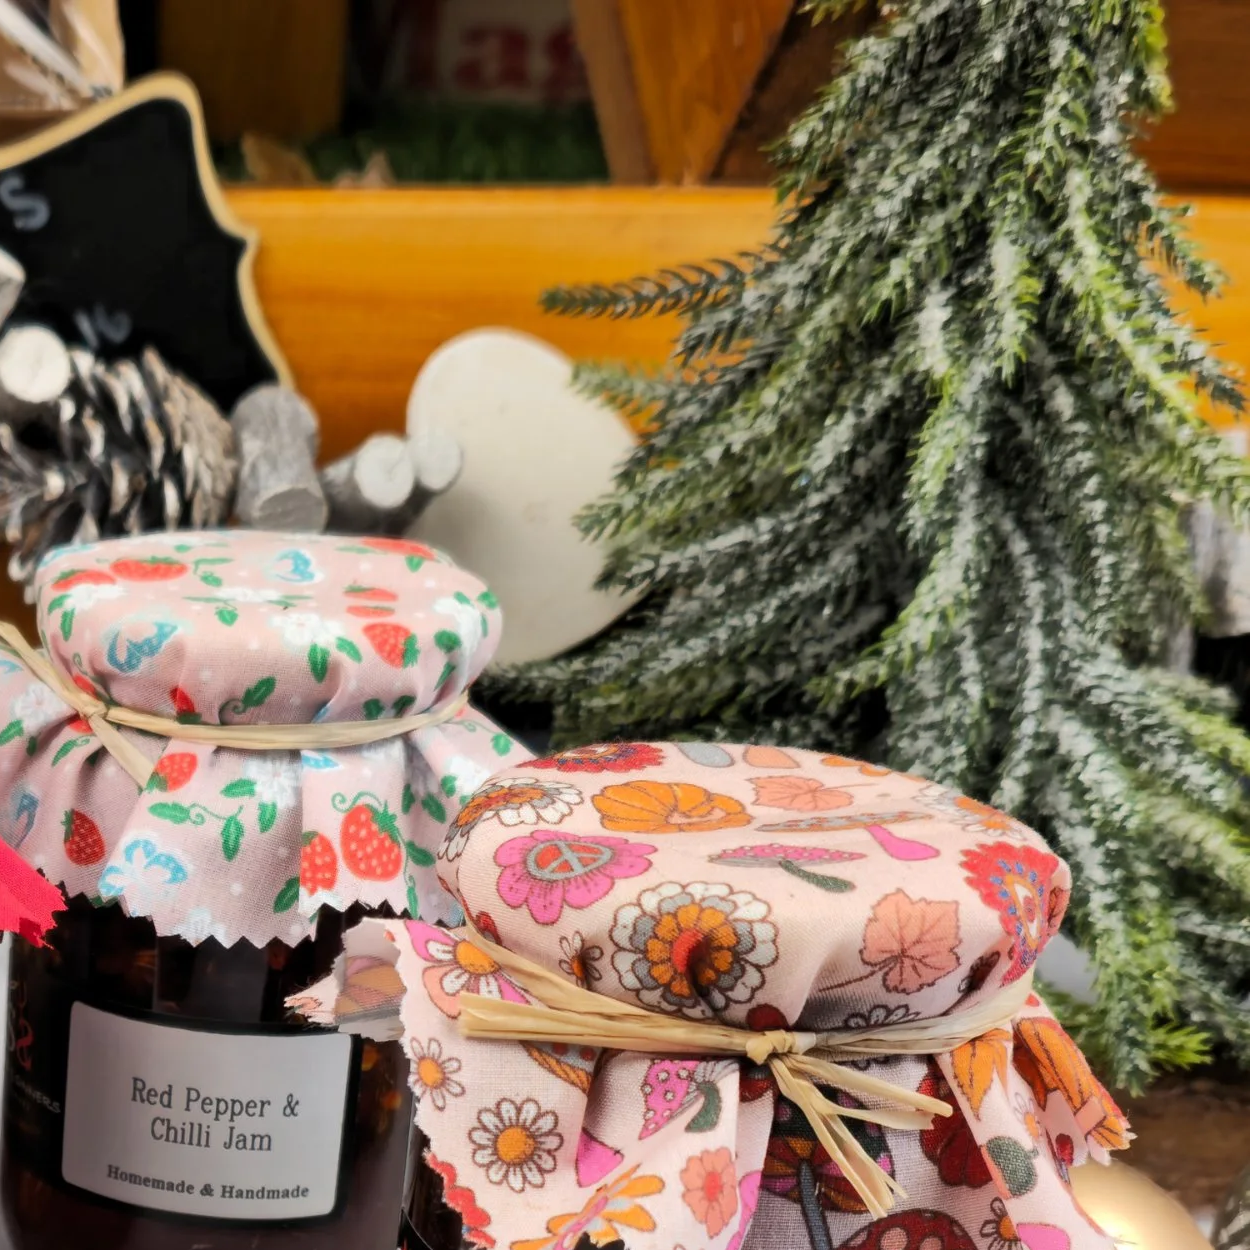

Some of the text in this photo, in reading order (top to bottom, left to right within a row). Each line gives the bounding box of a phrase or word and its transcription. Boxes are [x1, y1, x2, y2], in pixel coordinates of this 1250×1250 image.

[131, 1077, 300, 1123] Red Pepper &
[150, 1117, 272, 1151] Chilli Jam
[106, 1164, 310, 1200] Homemade & Handmade
